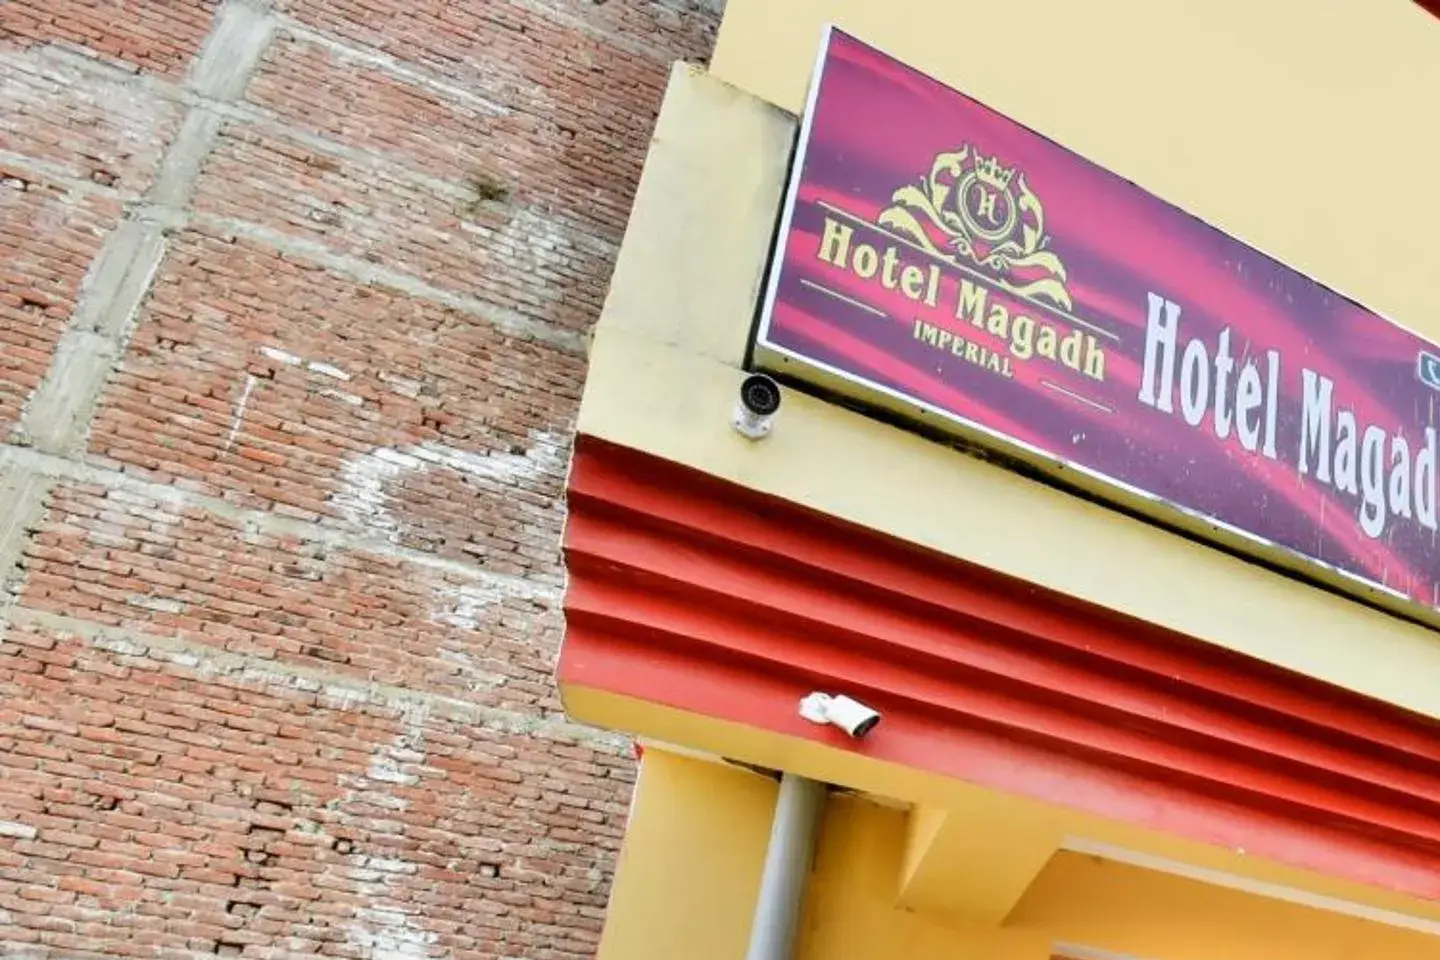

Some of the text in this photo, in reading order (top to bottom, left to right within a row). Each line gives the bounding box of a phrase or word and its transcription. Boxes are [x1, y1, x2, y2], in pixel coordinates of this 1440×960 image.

[818, 219, 1106, 382] Hotel Magadh
[913, 319, 1013, 377] IMPERIAL
[1138, 291, 1280, 460] Hotel
